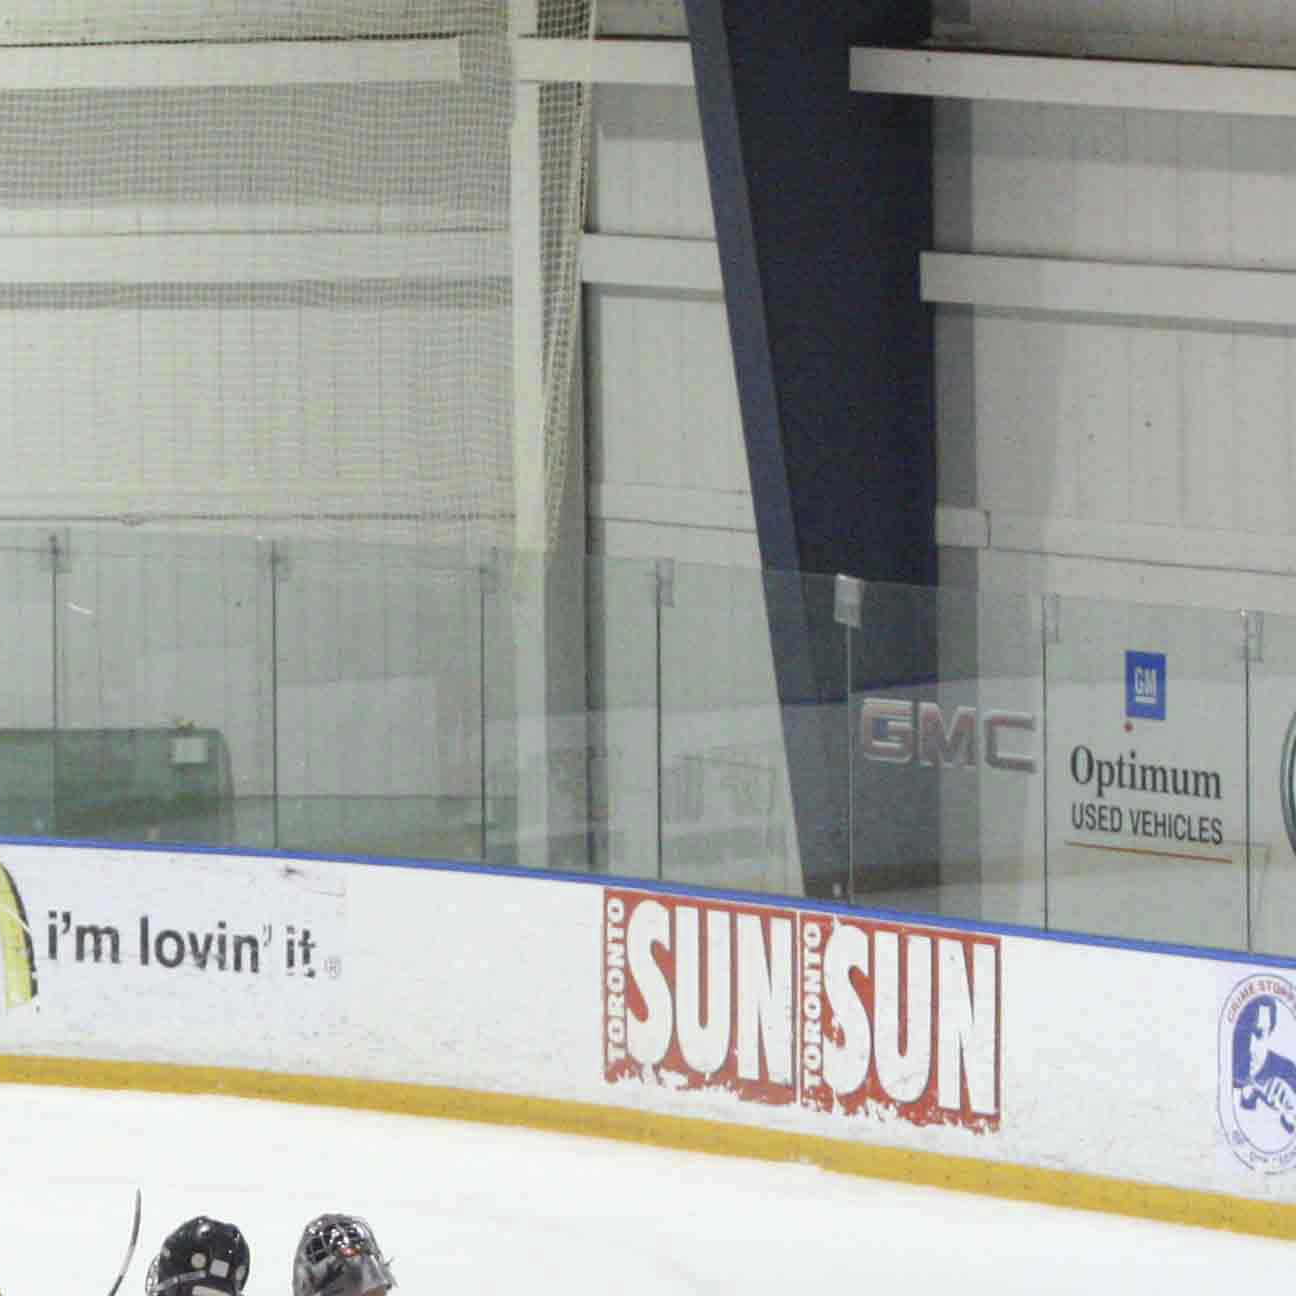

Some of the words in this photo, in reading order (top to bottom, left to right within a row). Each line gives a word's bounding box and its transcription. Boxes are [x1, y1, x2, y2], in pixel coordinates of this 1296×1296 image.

[861, 697, 1037, 774] GMC
[1070, 744, 1223, 800] Optimum
[1071, 803, 1124, 834] USED
[1131, 812, 1224, 845] VEHICLES
[47, 911, 121, 965] i'm
[139, 915, 274, 974] lovin'
[607, 896, 626, 1062] TORONTO
[625, 899, 796, 1087] SUN
[822, 919, 998, 1116] SUN
